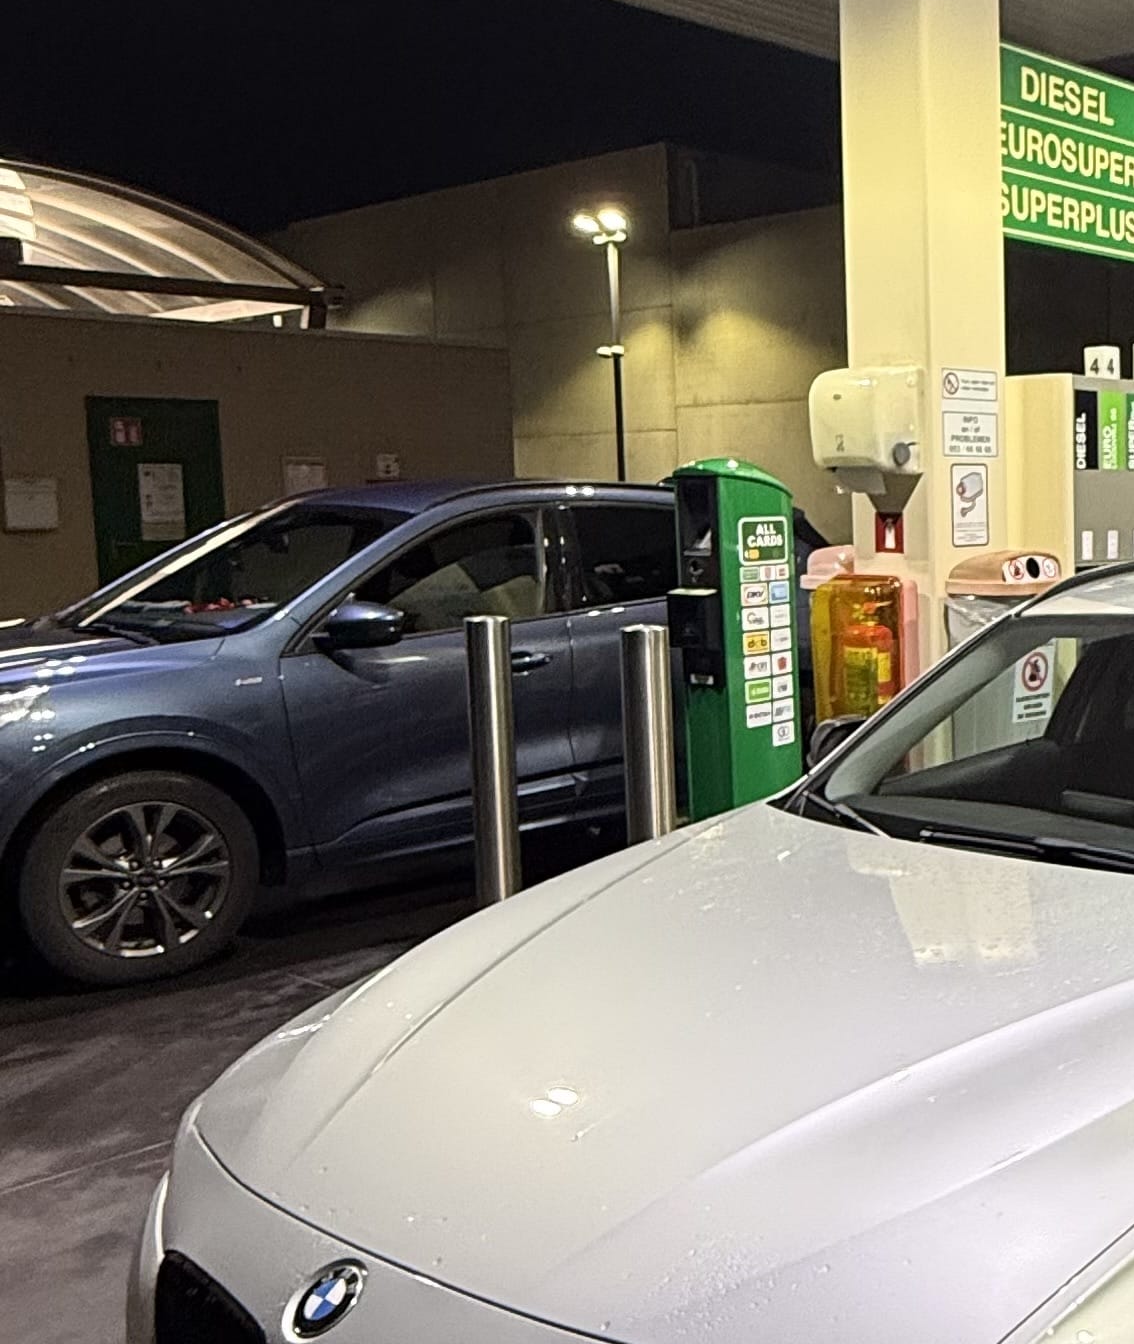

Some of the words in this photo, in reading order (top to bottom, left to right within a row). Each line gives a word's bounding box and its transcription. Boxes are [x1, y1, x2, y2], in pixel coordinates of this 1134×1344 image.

[1020, 65, 1115, 127] DIESEL
[1089, 358, 1099, 375] 4
[1106, 358, 1115, 375] 4
[1075, 412, 1086, 469] DIESEL
[756, 523, 776, 535] ALL
[747, 534, 783, 547] CARDS
